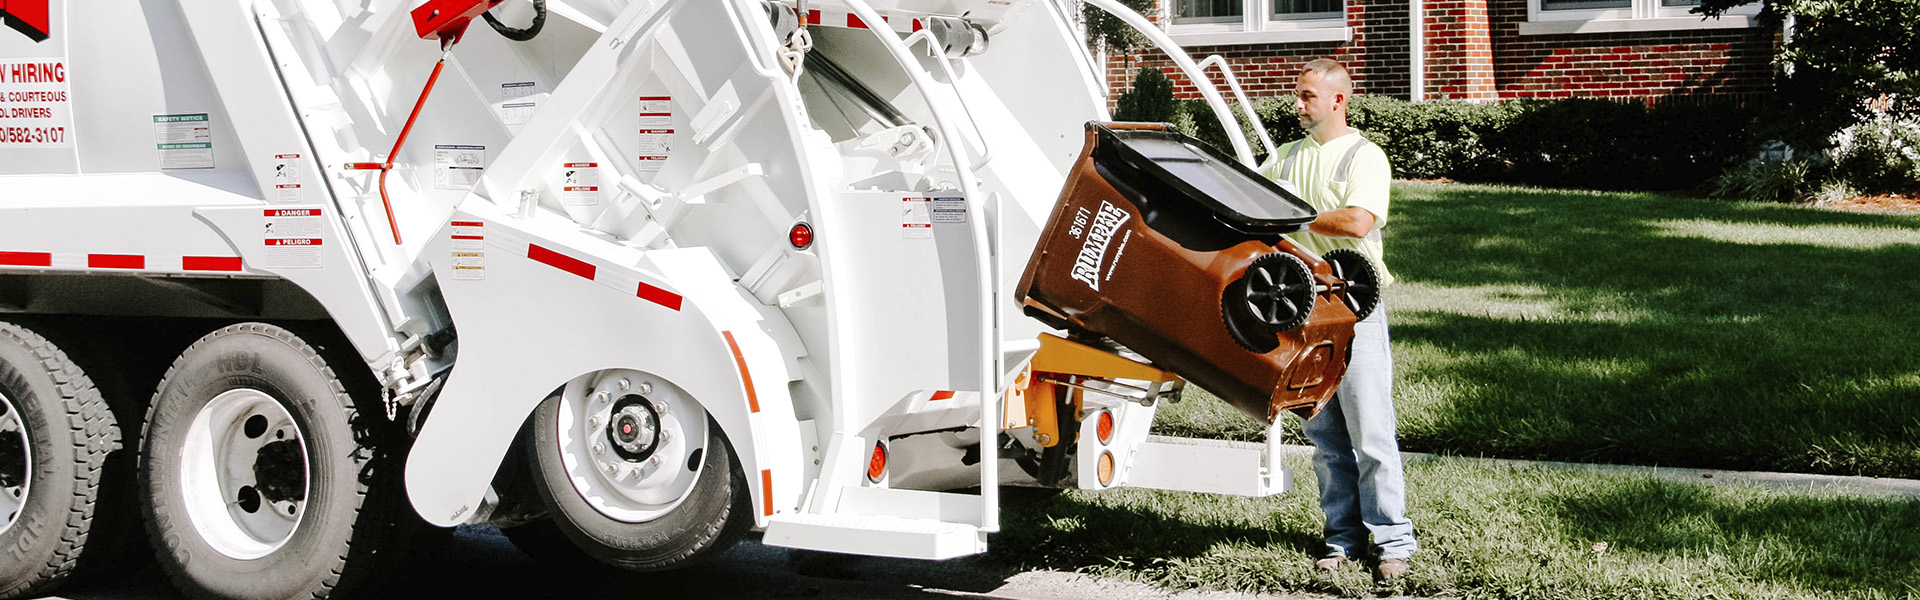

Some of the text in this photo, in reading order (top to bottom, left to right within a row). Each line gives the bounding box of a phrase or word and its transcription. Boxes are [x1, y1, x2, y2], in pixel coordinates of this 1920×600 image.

[11, 62, 65, 83] HIRING
[8, 91, 67, 102] COURTEOUS
[11, 107, 52, 118] DRIVERS
[1068, 206, 1091, 240] 361671
[1071, 200, 1131, 291] RUMPKE
[9, 511, 46, 561] HDL
